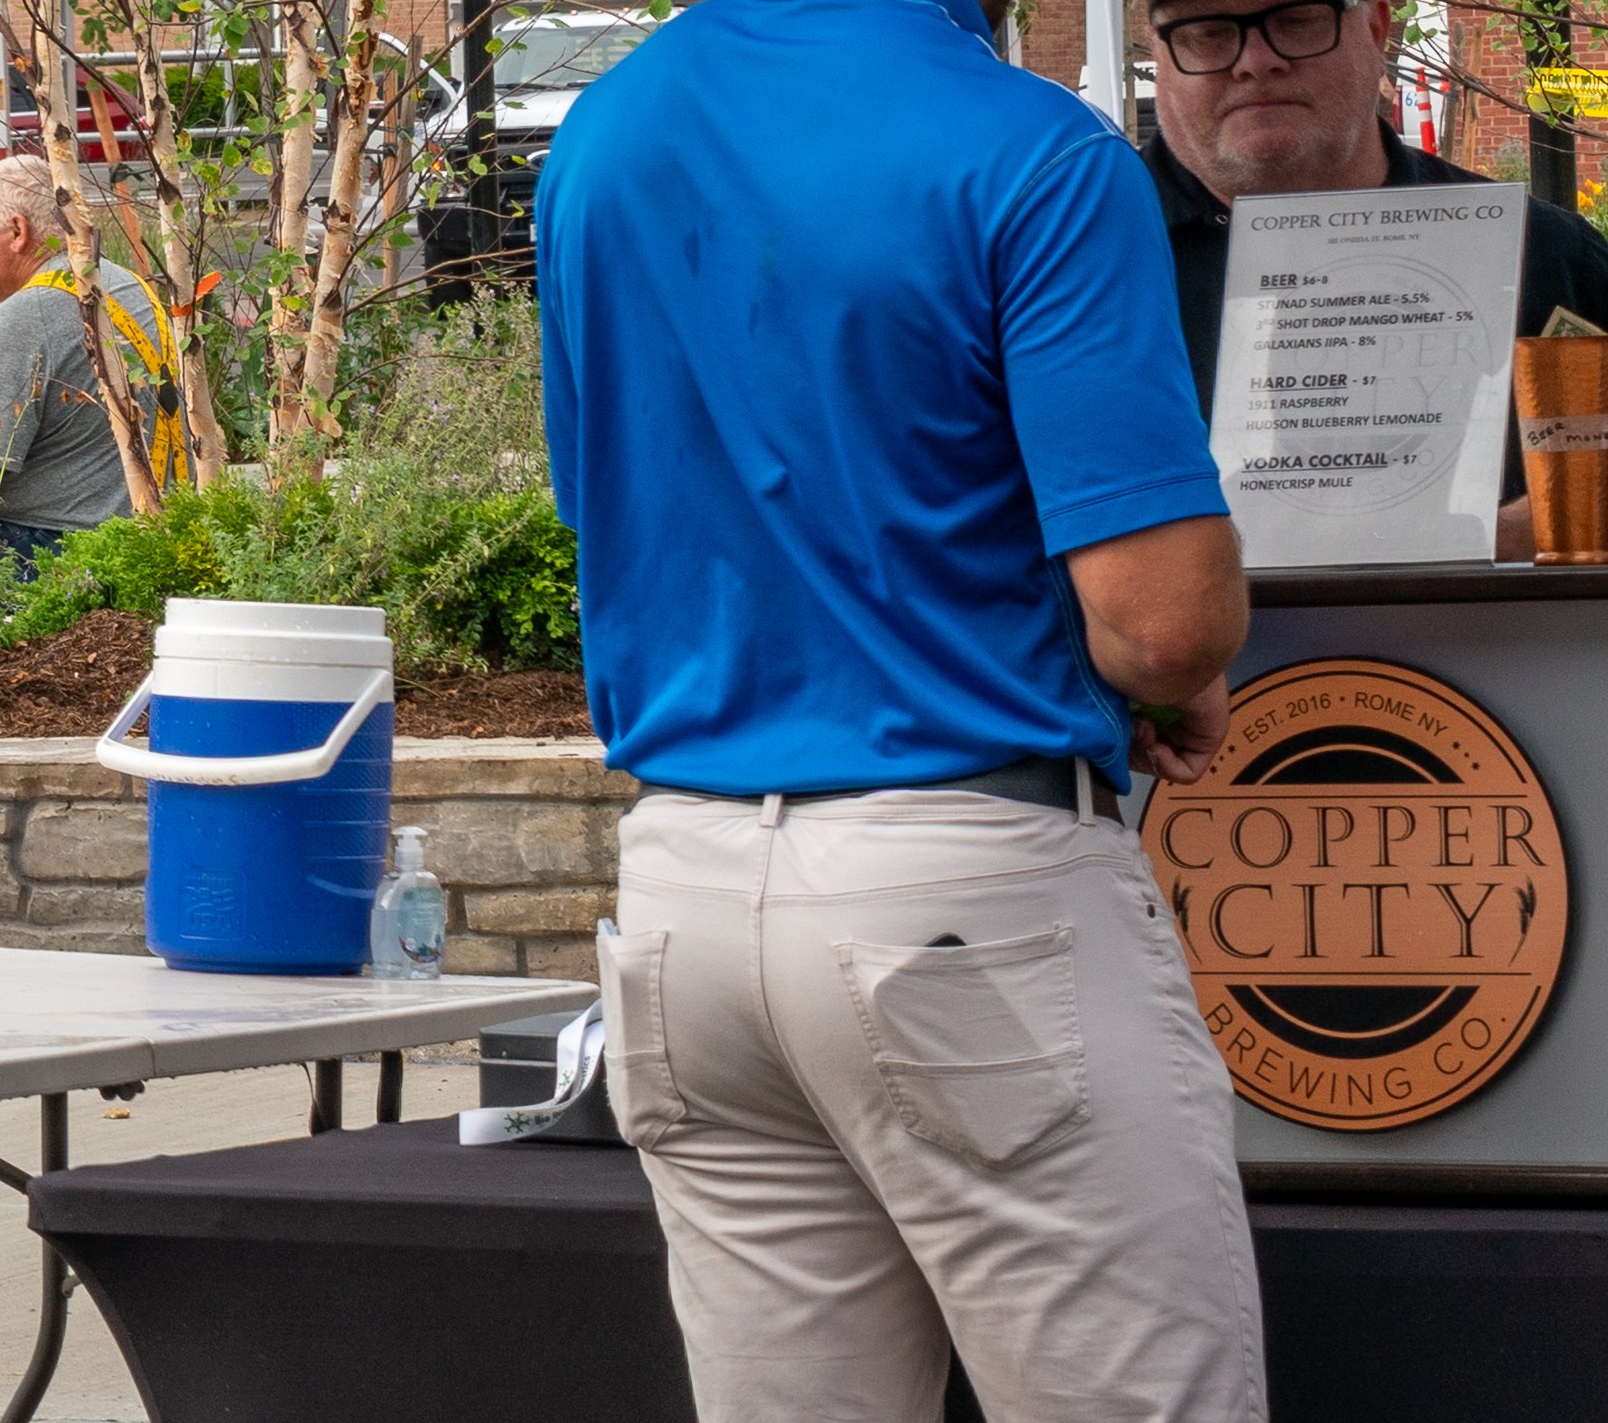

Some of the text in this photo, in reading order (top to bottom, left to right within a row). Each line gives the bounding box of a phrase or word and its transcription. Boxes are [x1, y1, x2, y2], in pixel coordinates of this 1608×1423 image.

[1251, 205, 1504, 231] COPPER CITY BREWING CO
[1260, 274, 1298, 288] BEER
[1257, 297, 1308, 310] STUNAD
[1309, 296, 1366, 308] SUMMER
[1368, 294, 1392, 306] ALE
[1400, 292, 1431, 304] 5.5%
[1276, 317, 1309, 330] SHOT
[1312, 316, 1346, 328] DROP
[1348, 313, 1399, 326] MANGO
[1401, 311, 1445, 324] WHEAT
[1455, 310, 1474, 322] 5%
[1253, 337, 1322, 351] GALAXIANS
[1358, 335, 1377, 347] 8%
[1249, 376, 1297, 390] HARD
[1301, 374, 1348, 389] CIDER
[1362, 375, 1377, 386] $7
[1248, 396, 1350, 410] 1911 RASPBERRY
[1246, 413, 1443, 431] HUDSON BLUEBERRY LEMONADE
[1527, 422, 1566, 446] BEER
[1243, 455, 1304, 471] VODKA
[1308, 452, 1389, 468] COCKTAIL
[1403, 454, 1418, 465] $7
[1239, 477, 1353, 491] HONEYCRISP MULE
[1242, 691, 1450, 744] EST. 2016 ROME NY
[1159, 804, 1550, 870] COPPER
[1208, 882, 1505, 960] CITY
[1204, 1002, 1414, 1107] BREWING
